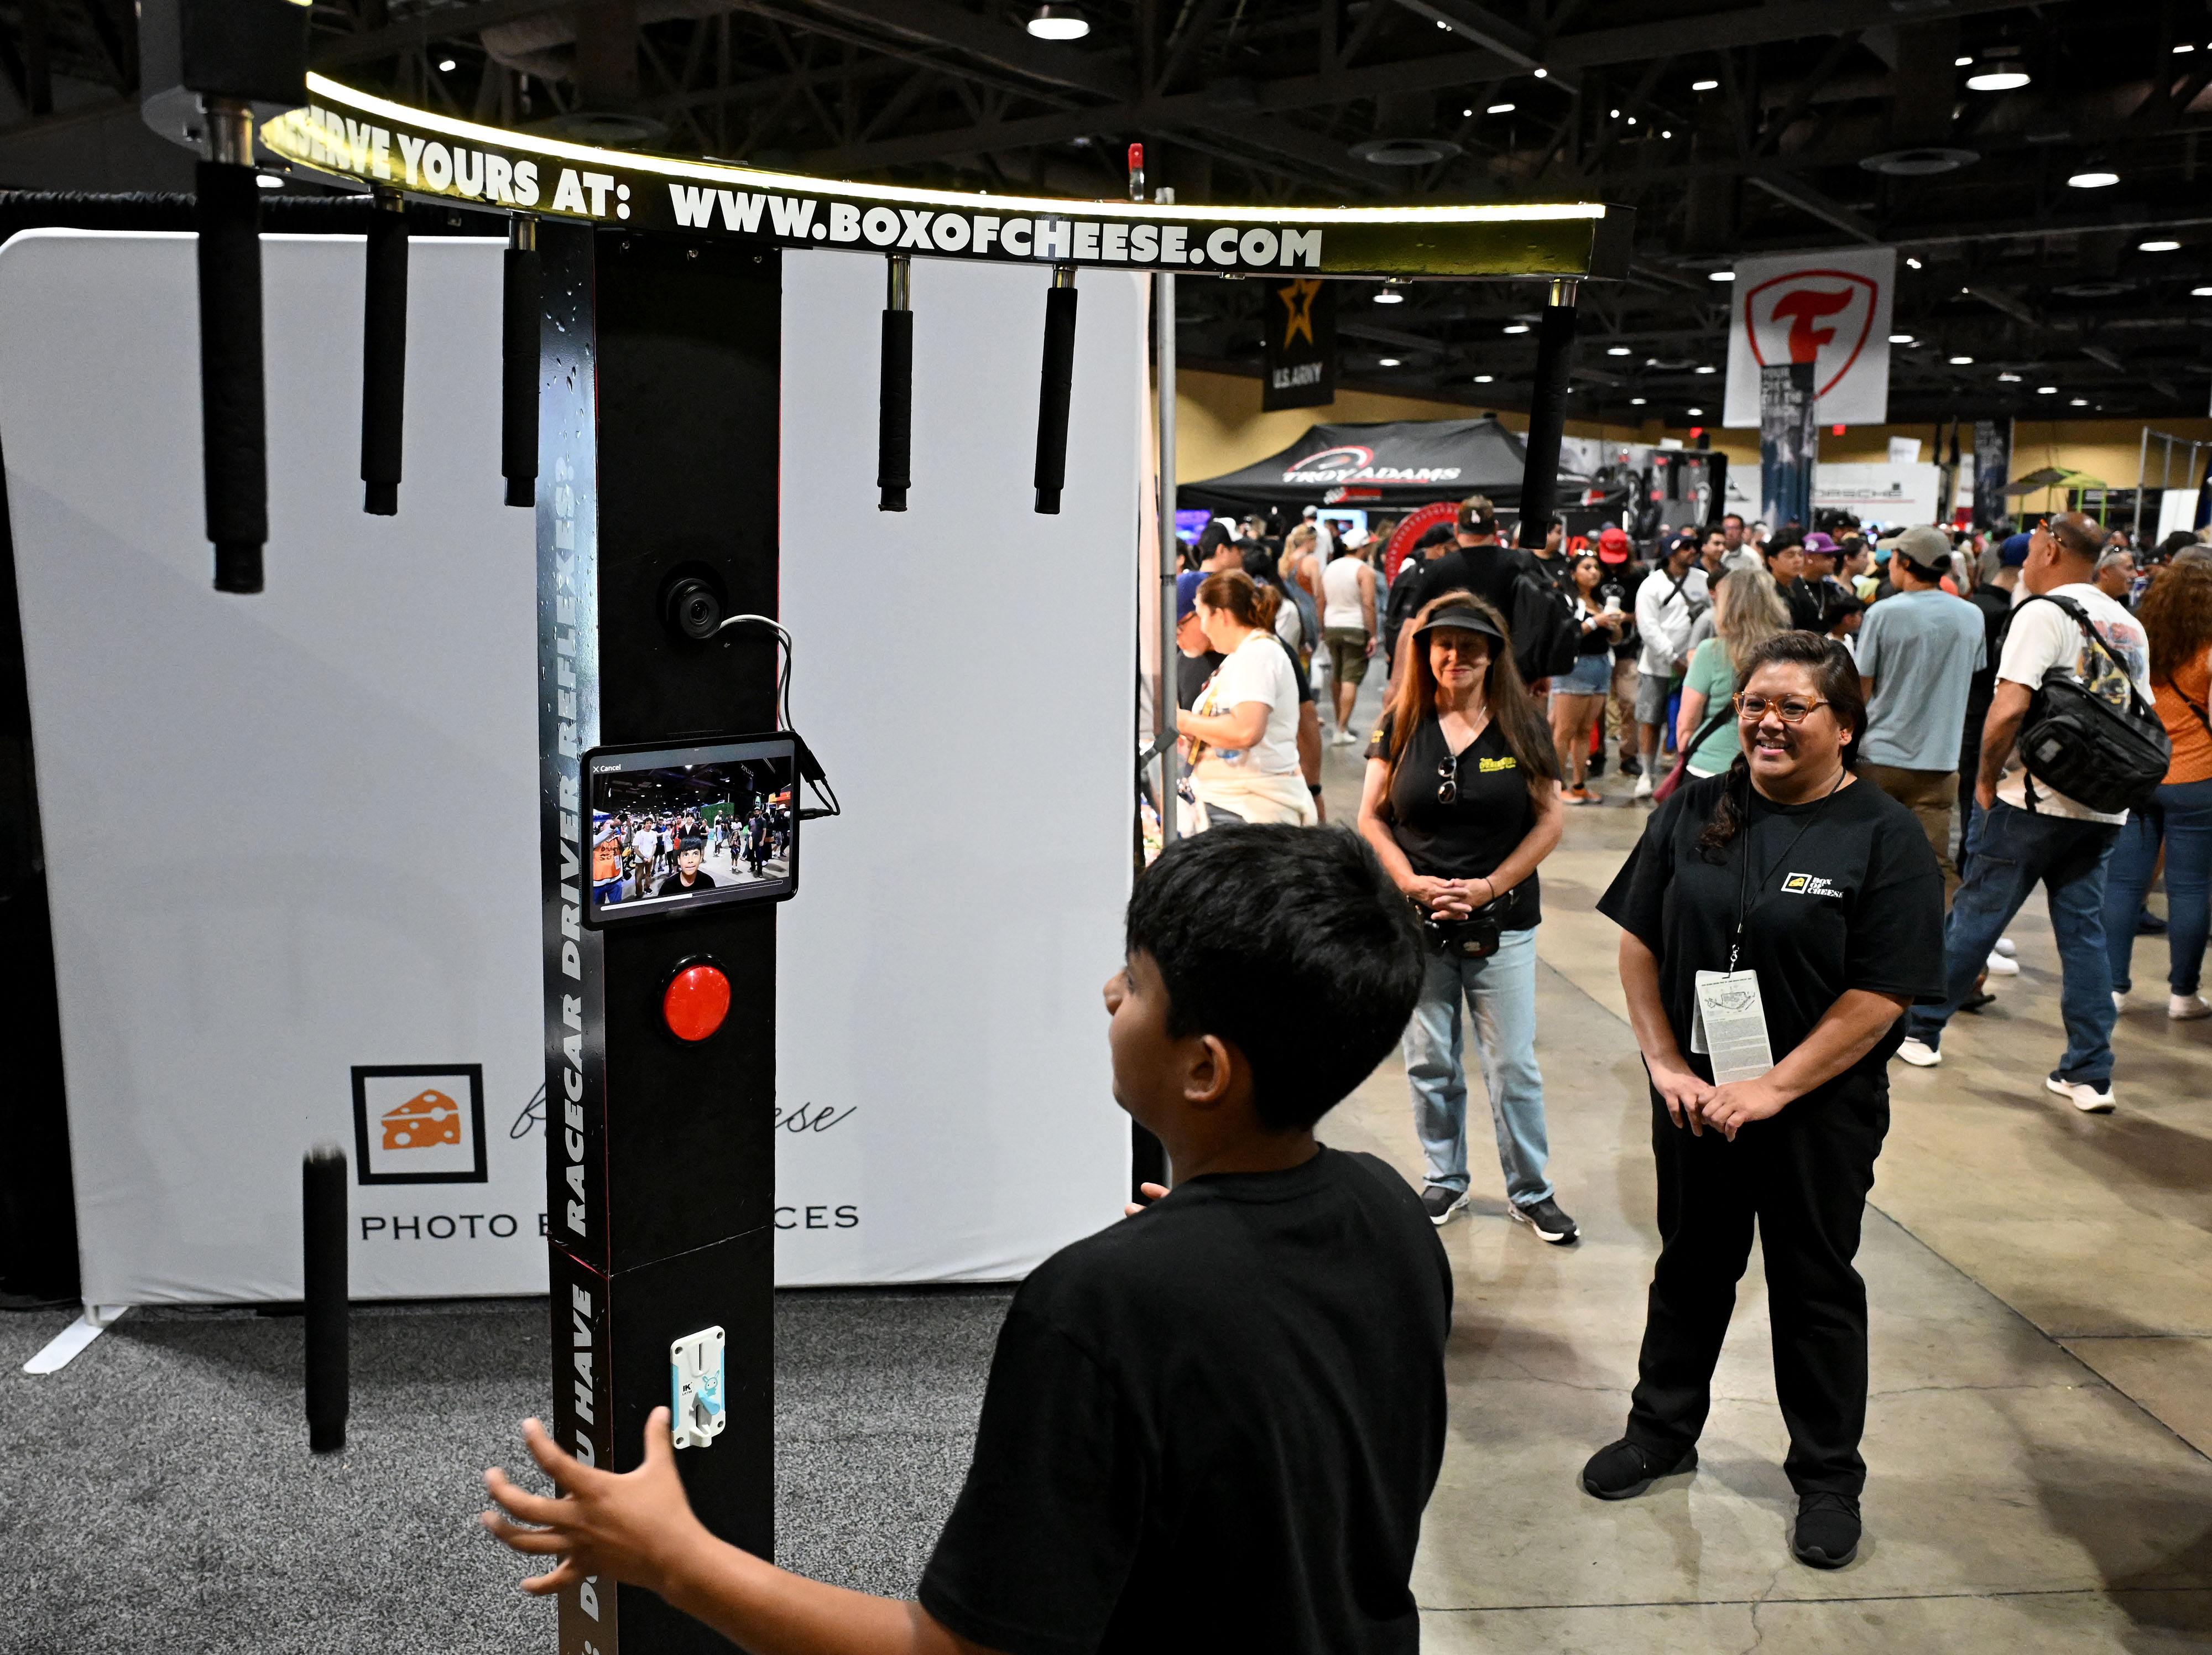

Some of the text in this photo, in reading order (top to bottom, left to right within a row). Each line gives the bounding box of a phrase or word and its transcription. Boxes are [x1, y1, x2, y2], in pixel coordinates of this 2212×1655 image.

[396, 133, 540, 207] YOURS
[552, 168, 631, 220] AT:
[669, 183, 1322, 268] WWW.BOXOFCHEESE.COM
[600, 763, 622, 772] Cancel
[559, 775, 581, 980] DRIVER
[1807, 888, 1844, 898] CHEESE
[1812, 877, 1833, 885] BOX
[562, 994, 586, 1237] RACECAR
[361, 1214, 518, 1240] PHOTO
[573, 1284, 594, 1425] HAVE
